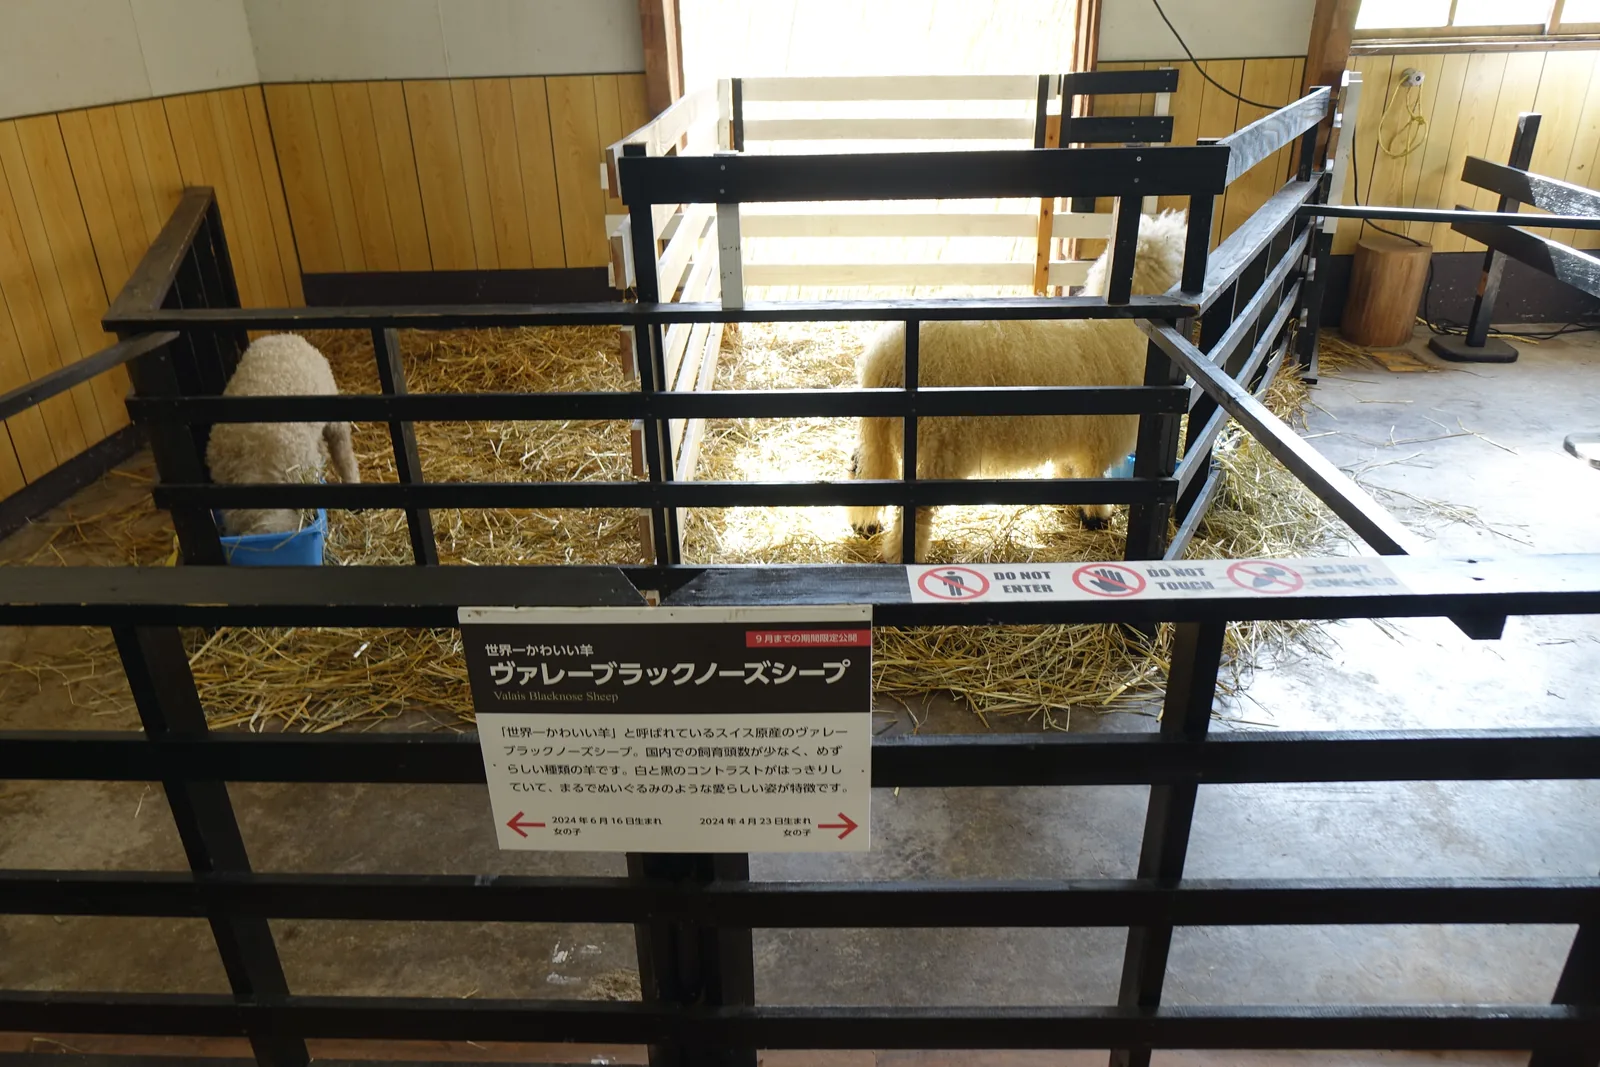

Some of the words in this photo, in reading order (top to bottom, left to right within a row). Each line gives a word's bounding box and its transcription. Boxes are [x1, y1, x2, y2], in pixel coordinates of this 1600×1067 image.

[993, 571, 1017, 580] DO
[1020, 571, 1051, 580] NOT
[1146, 568, 1169, 577] DO
[1172, 567, 1205, 577] NOT
[1002, 584, 1054, 593] ENTER
[1155, 581, 1215, 590] TOUCH
[755, 633, 858, 643] 9月までの期間限定公開
[485, 643, 594, 657] 世界一かわいい羊
[489, 659, 851, 686] ヴァレーブラックノーズシープ
[494, 691, 526, 701] Valais
[529, 691, 584, 701] Blacknose
[586, 692, 619, 703] Sheep
[553, 828, 582, 836] 女の子
[783, 829, 812, 837] 女の子
